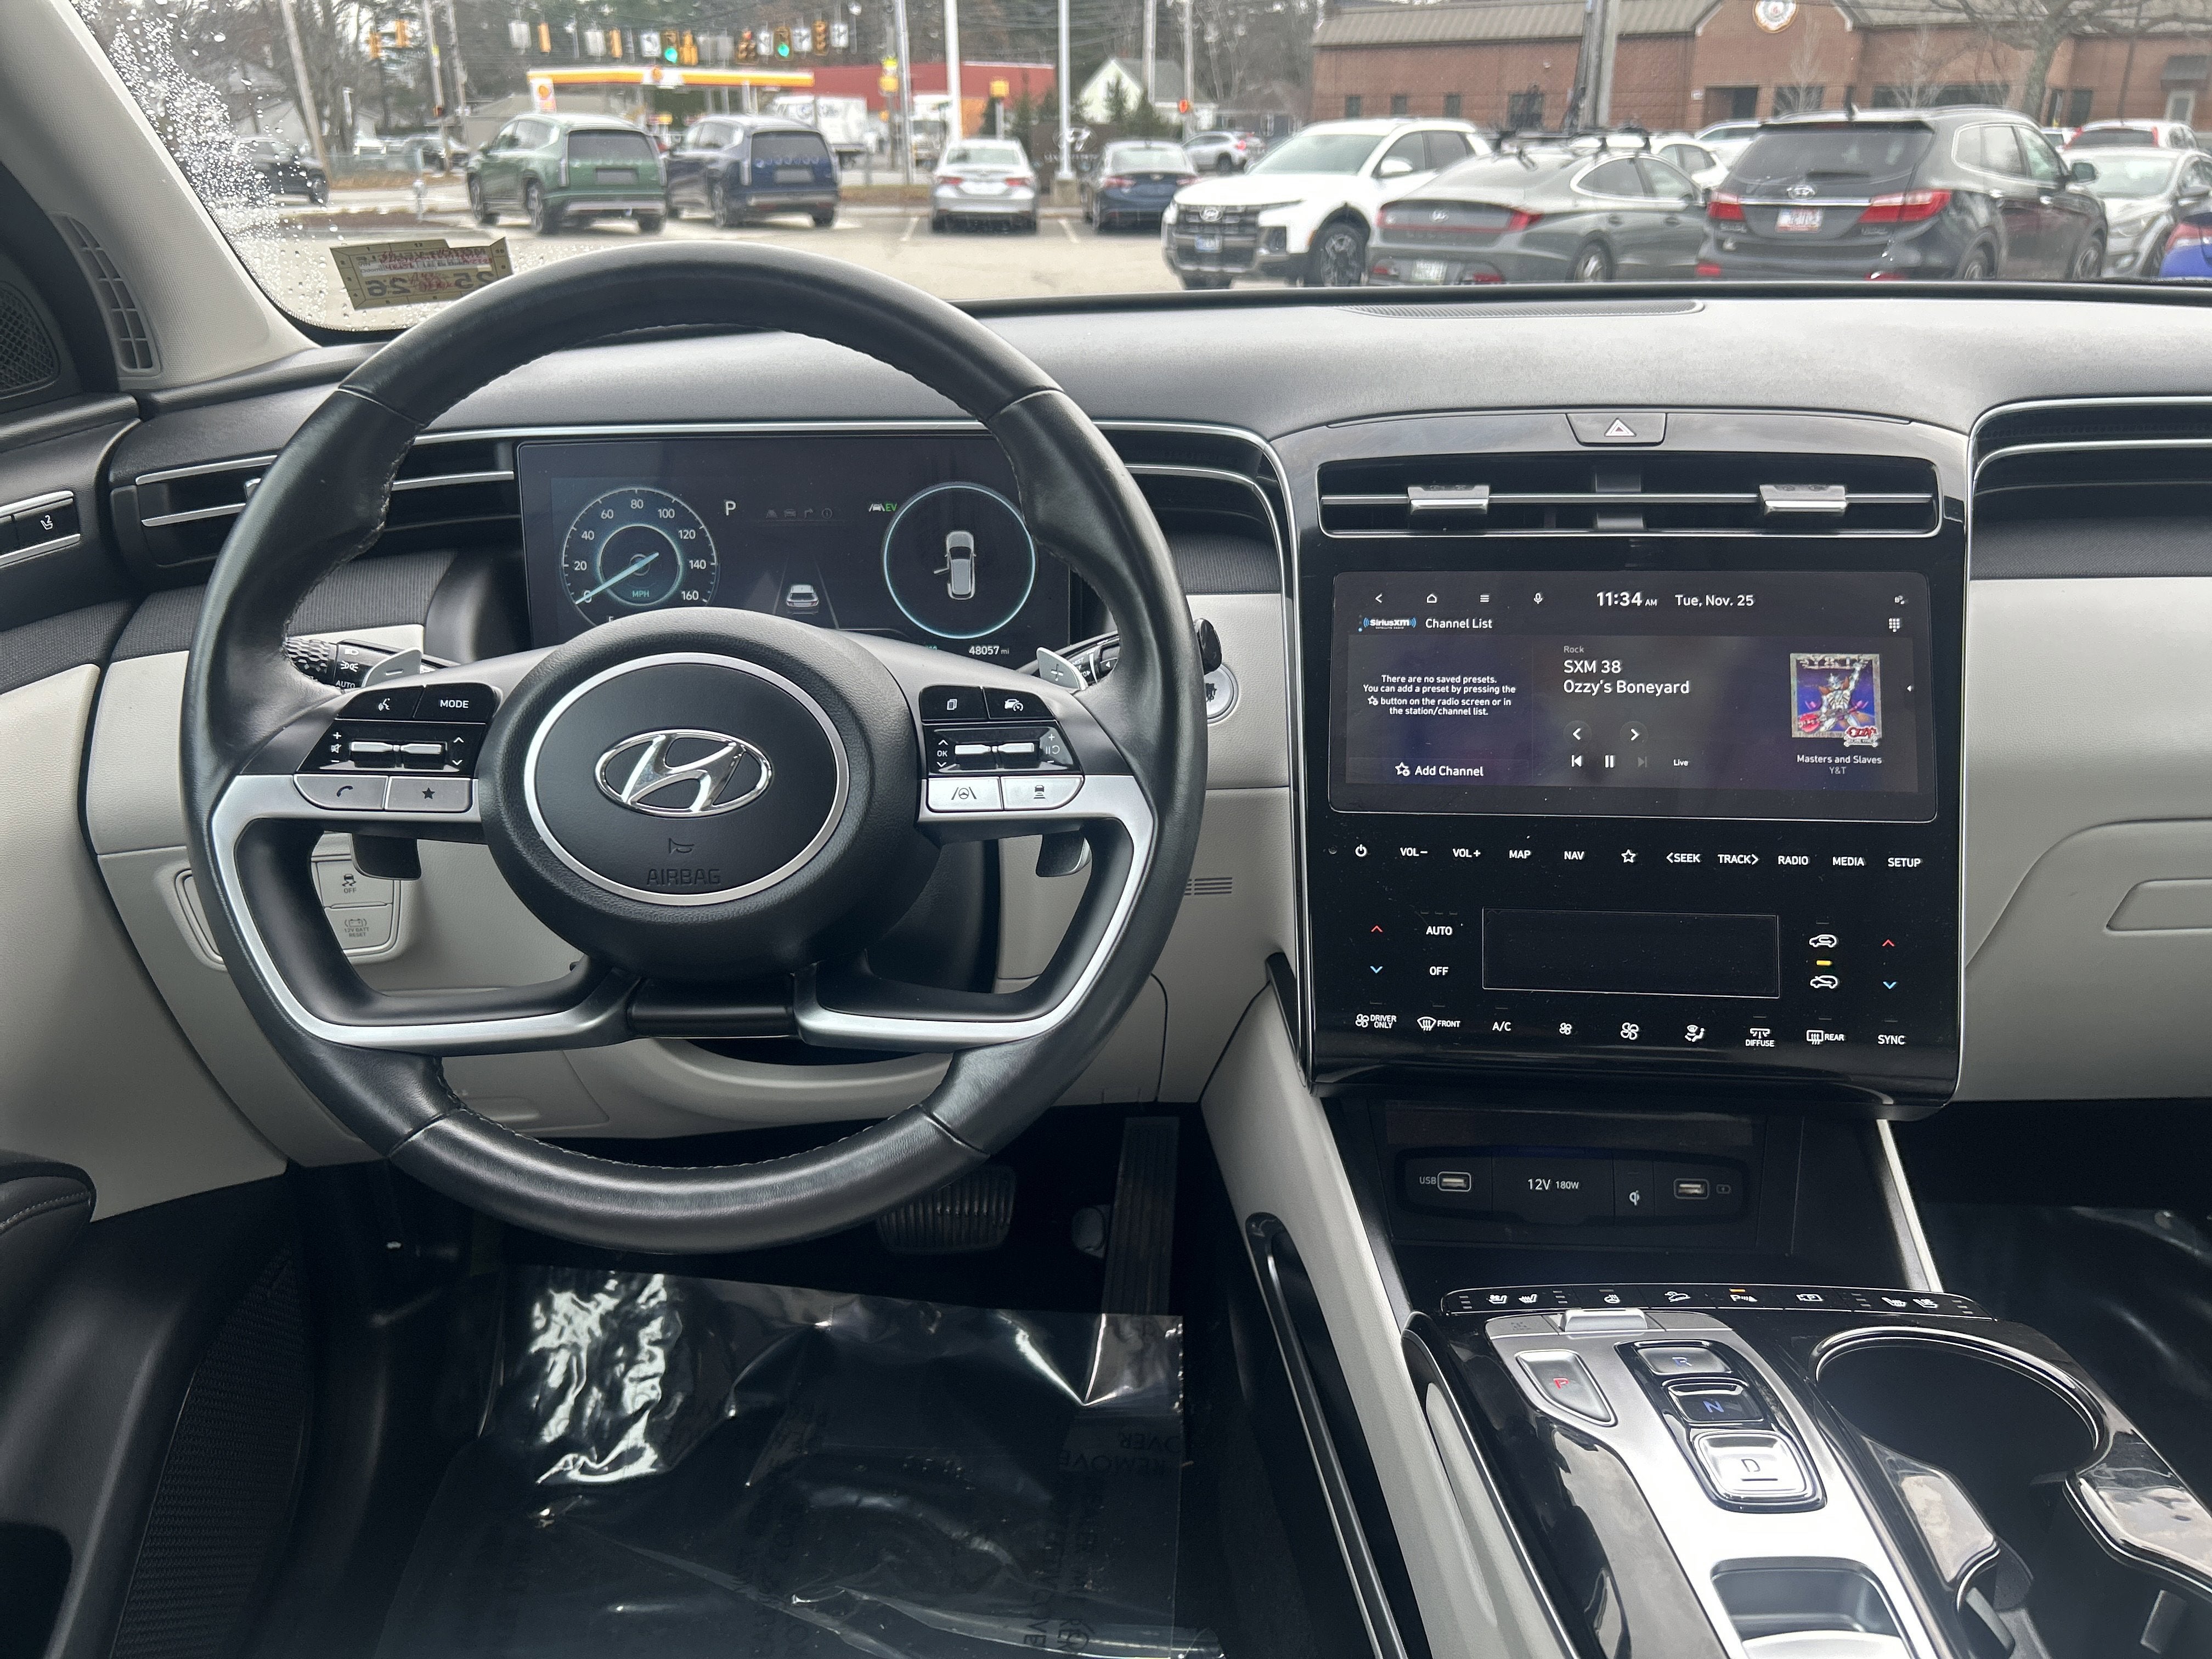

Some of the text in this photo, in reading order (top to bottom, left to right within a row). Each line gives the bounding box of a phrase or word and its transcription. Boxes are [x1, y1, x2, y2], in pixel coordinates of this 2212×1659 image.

[630, 499, 644, 509] 80
[725, 500, 736, 516] P
[885, 503, 898, 512] EV
[601, 509, 614, 520] 60
[657, 508, 675, 518] 100
[581, 530, 595, 540] 40
[678, 529, 696, 539] 120
[574, 560, 587, 571] 20
[689, 559, 707, 569] 140
[583, 590, 592, 603] 0
[681, 590, 699, 601] 160
[1596, 591, 1643, 607] 11:34
[1674, 594, 1703, 607] Tue,
[1706, 595, 1733, 606] Nov.
[1737, 594, 1754, 606] 25
[1425, 618, 1493, 629] Channel List
[968, 645, 1000, 655] 48057
[1564, 645, 1584, 653] Rock
[1564, 659, 1622, 674] SXM 38
[336, 680, 356, 689] AUTO
[1381, 674, 1406, 683] There
[1436, 675, 1461, 684] saved
[1463, 675, 1497, 685] presets.
[1363, 684, 1379, 692] You
[1397, 684, 1413, 692] add
[1421, 685, 1449, 694] preset
[1451, 684, 1462, 695] by
[1463, 685, 1500, 695] pressing
[1502, 685, 1516, 693] the
[1564, 679, 1689, 697] Ozzy's Boneyard
[440, 699, 469, 708] MODE
[1380, 697, 1408, 705] button
[1421, 697, 1436, 706] the
[1437, 697, 1460, 706] radio
[1503, 697, 1511, 706] in
[1389, 706, 1489, 716] the station/channel list.
[1797, 754, 1882, 764] Masters and Slaves
[1414, 765, 1484, 777] Add Channel
[1829, 766, 1847, 775] Y&T
[1509, 849, 1531, 859] MAP
[1564, 850, 1584, 860] NAV
[1778, 855, 1809, 865] RADIO
[1832, 856, 1865, 866] MEDIA
[1887, 857, 1921, 867] SETUP
[646, 868, 721, 885] AIRBAG
[1426, 926, 1453, 936] AUTO
[1429, 966, 1449, 976] OFF
[1370, 1014, 1397, 1023] DRIVER
[1374, 1020, 1393, 1029] ONLY
[1492, 1021, 1511, 1032] A/C
[1824, 1033, 1845, 1041] REAR
[1877, 1034, 1906, 1045] SYNC
[1745, 1039, 1775, 1047] DIFFUSE
[1419, 1176, 1436, 1185] USB
[1527, 1178, 1579, 1190] 12V 180W
[1673, 1356, 1691, 1367] R
[1553, 1377, 1569, 1389] P
[1703, 1399, 1724, 1414] N
[1741, 1459, 1761, 1471] D
